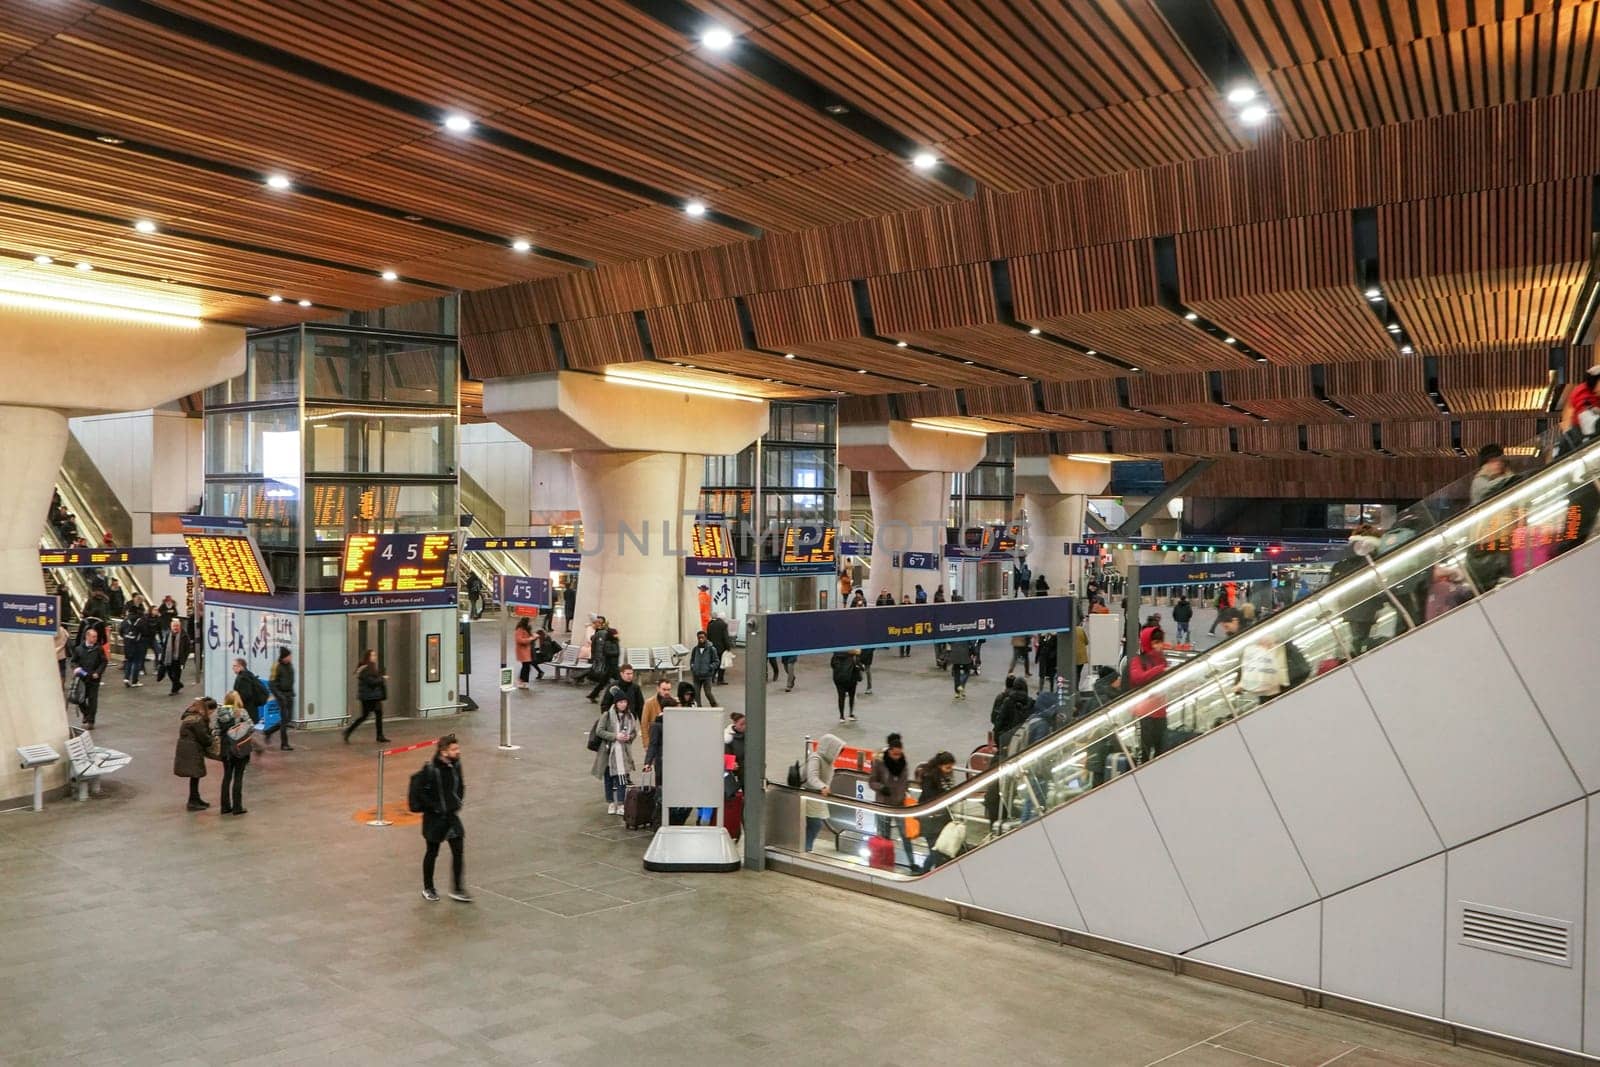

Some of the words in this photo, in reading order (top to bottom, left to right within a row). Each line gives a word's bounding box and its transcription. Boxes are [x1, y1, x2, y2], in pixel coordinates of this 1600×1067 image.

[382, 544, 393, 560] 4
[406, 544, 418, 560] 5
[910, 557, 915, 566] 6
[920, 557, 925, 566] 7
[736, 579, 750, 589] Lift
[512, 585, 519, 598] 4
[525, 585, 532, 599] 5
[3, 602, 37, 611] Underground
[277, 618, 292, 635] Lift
[888, 626, 900, 636] Way
[902, 626, 913, 634] out
[940, 621, 977, 632] Underground
